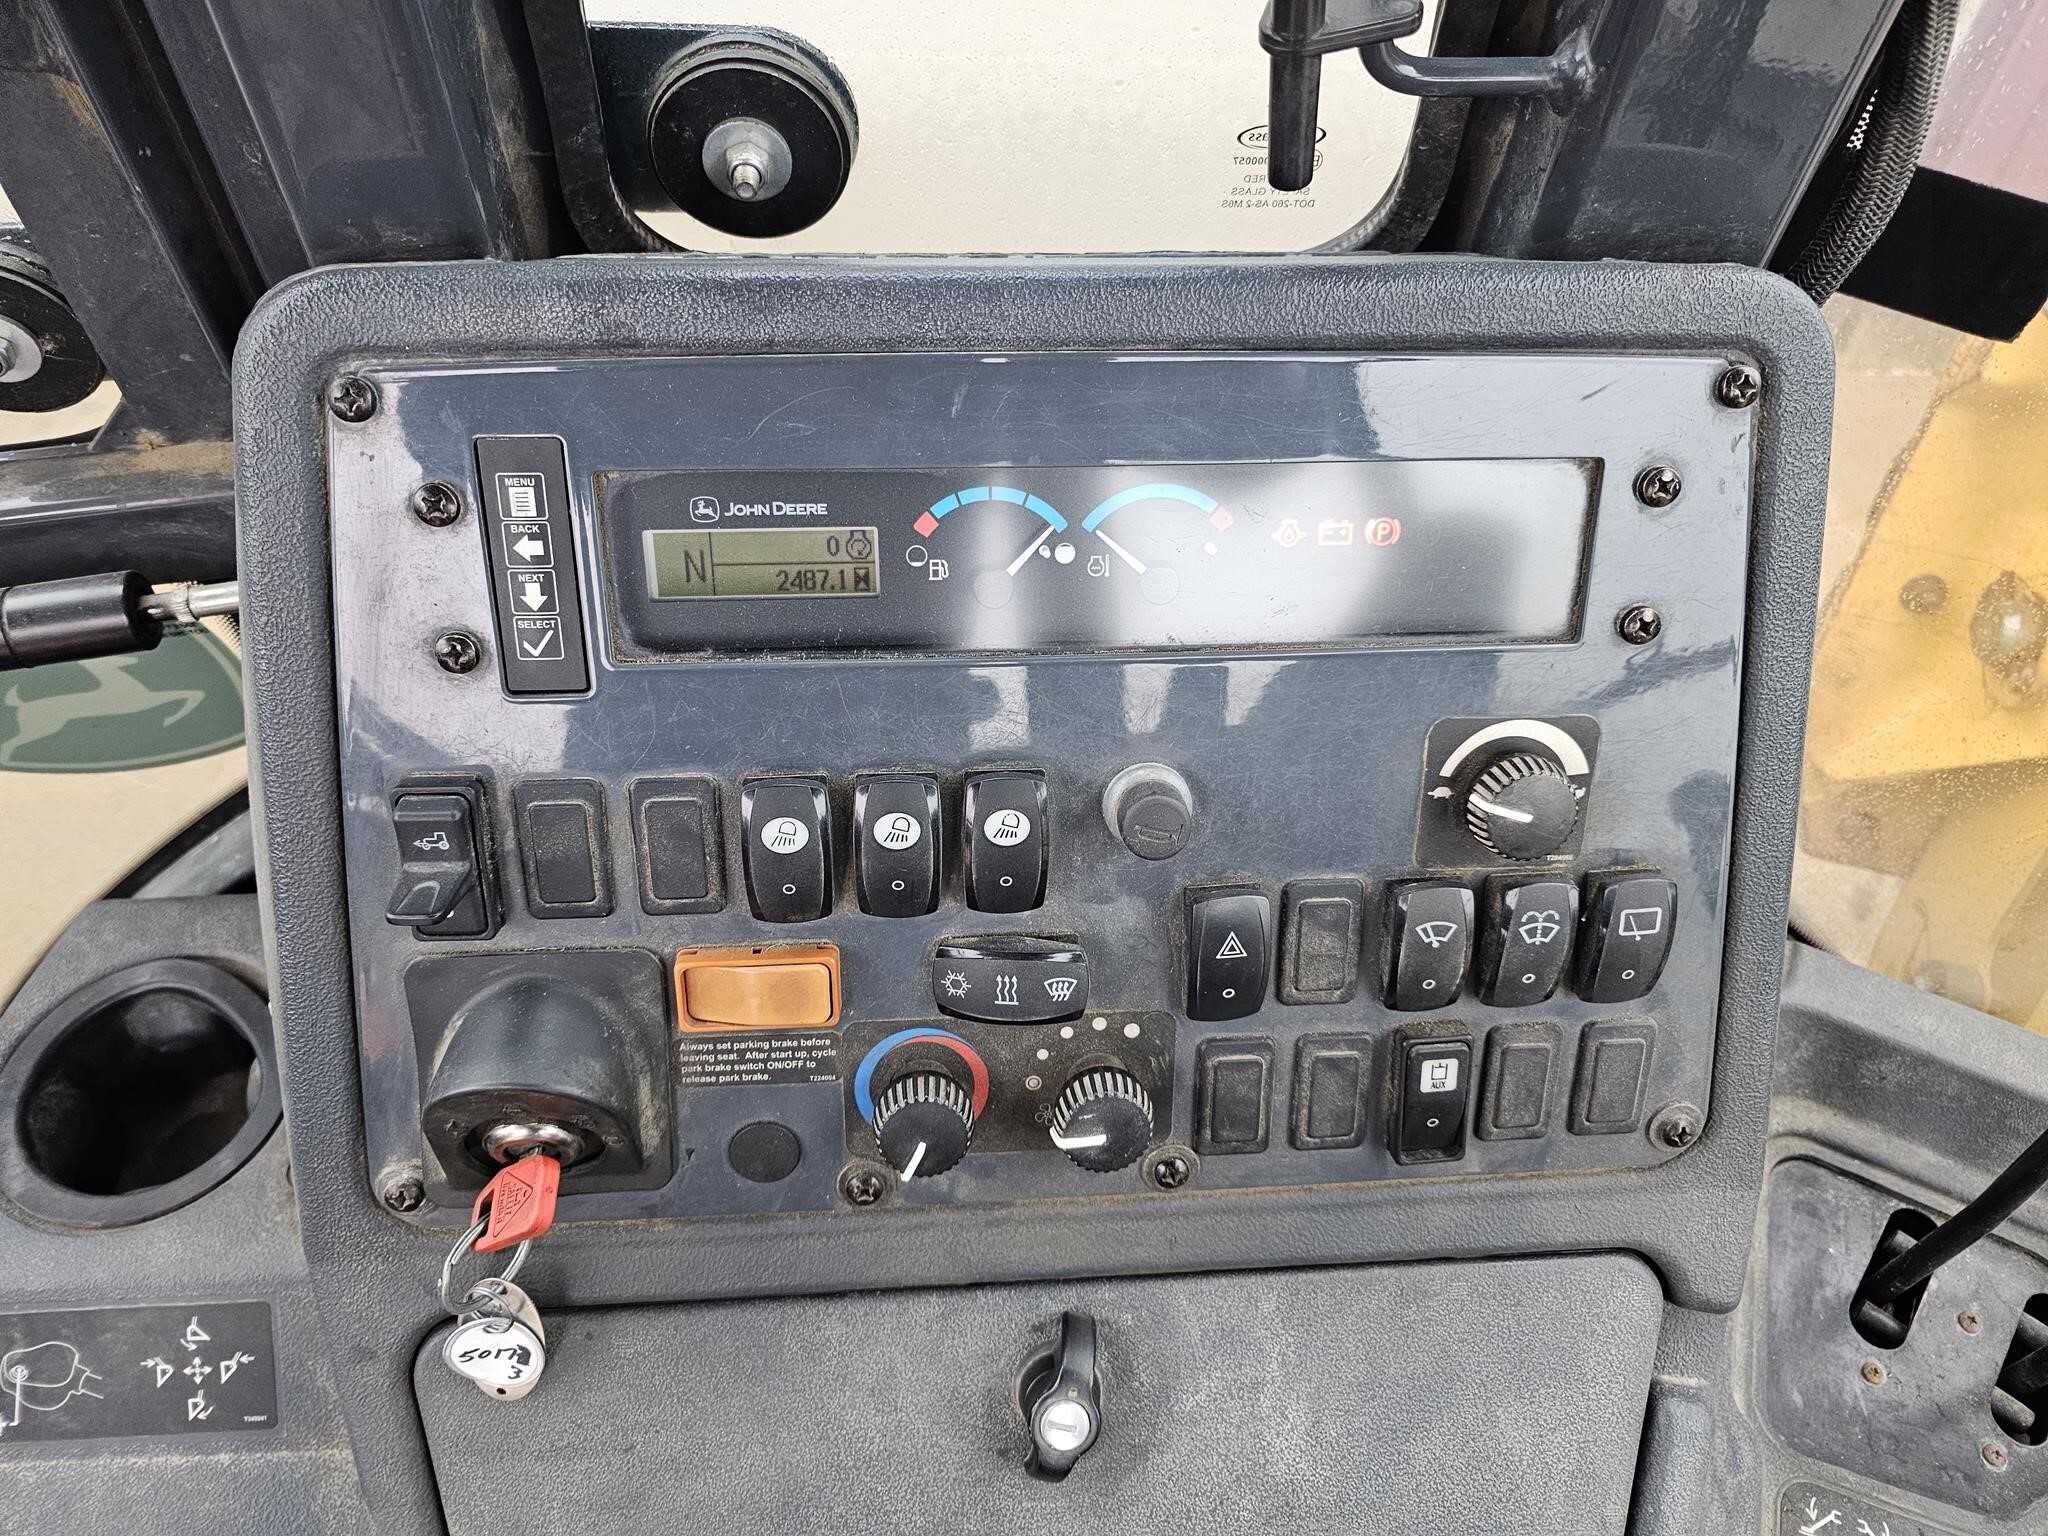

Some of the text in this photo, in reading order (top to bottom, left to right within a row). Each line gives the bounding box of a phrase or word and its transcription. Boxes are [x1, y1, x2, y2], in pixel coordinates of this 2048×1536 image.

[504, 477, 535, 487] MENU
[724, 501, 828, 517] JOHN DEERE
[510, 524, 541, 534] BACK
[826, 535, 840, 557] 0
[683, 549, 707, 584] N
[518, 573, 545, 583] NEXT
[775, 569, 847, 592] 2487.1
[517, 620, 556, 629] SELECT
[679, 1037, 831, 1052] Always set parking brake before
[680, 1052, 715, 1062] leaving
[716, 1052, 740, 1060] seat.
[745, 1050, 769, 1060] After
[771, 1050, 793, 1059] start
[811, 1048, 837, 1058] cycle
[681, 1060, 817, 1074] park brake switch ON/OFF to
[682, 1075, 717, 1083] release
[718, 1073, 740, 1083] park
[1430, 1081, 1446, 1089] AUX
[508, 1364, 523, 1380] 3
